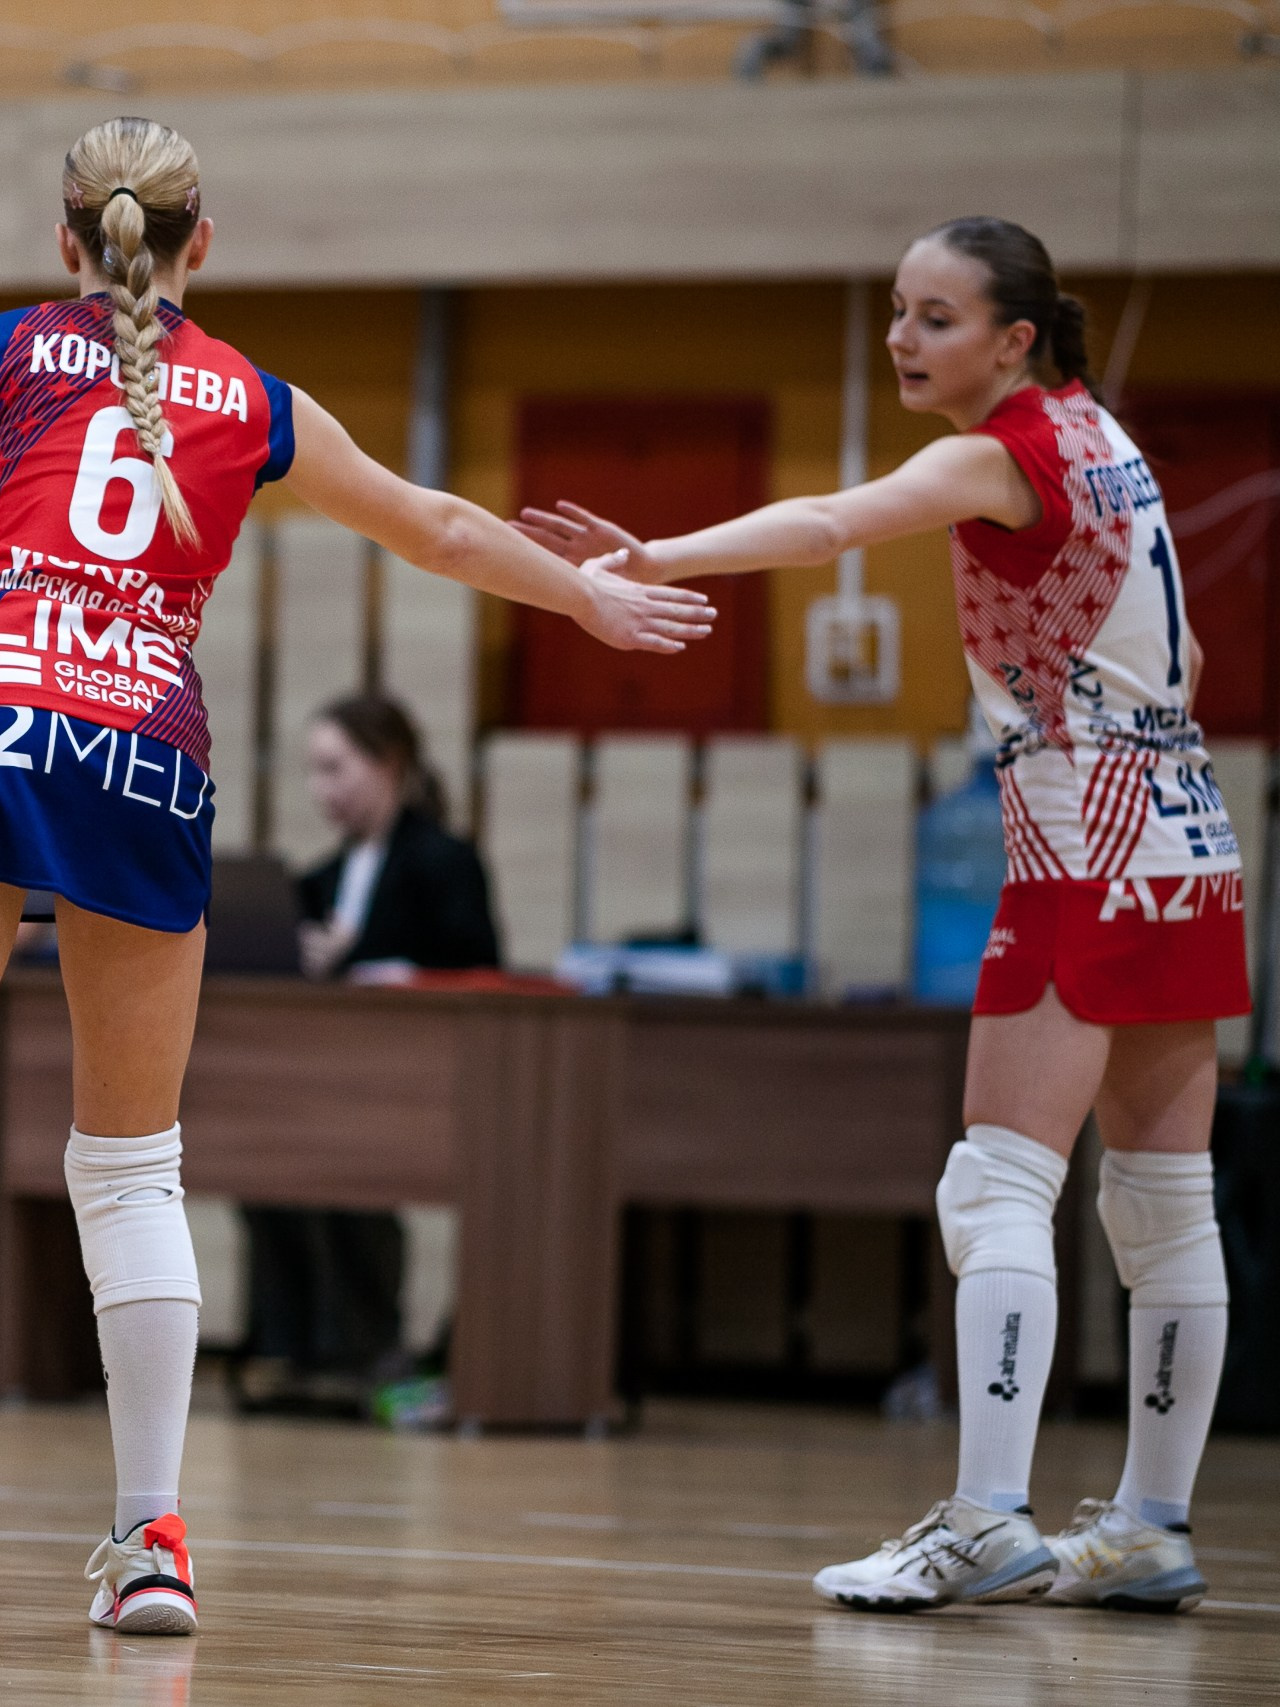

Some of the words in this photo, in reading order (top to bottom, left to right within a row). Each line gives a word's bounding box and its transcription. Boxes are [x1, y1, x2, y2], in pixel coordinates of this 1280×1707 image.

[68, 405, 175, 562] 6
[1148, 526, 1183, 688] 1
[53, 660, 167, 702] GLOBAL
[54, 675, 154, 714] VISION
[1098, 872, 1244, 923] A2ME
